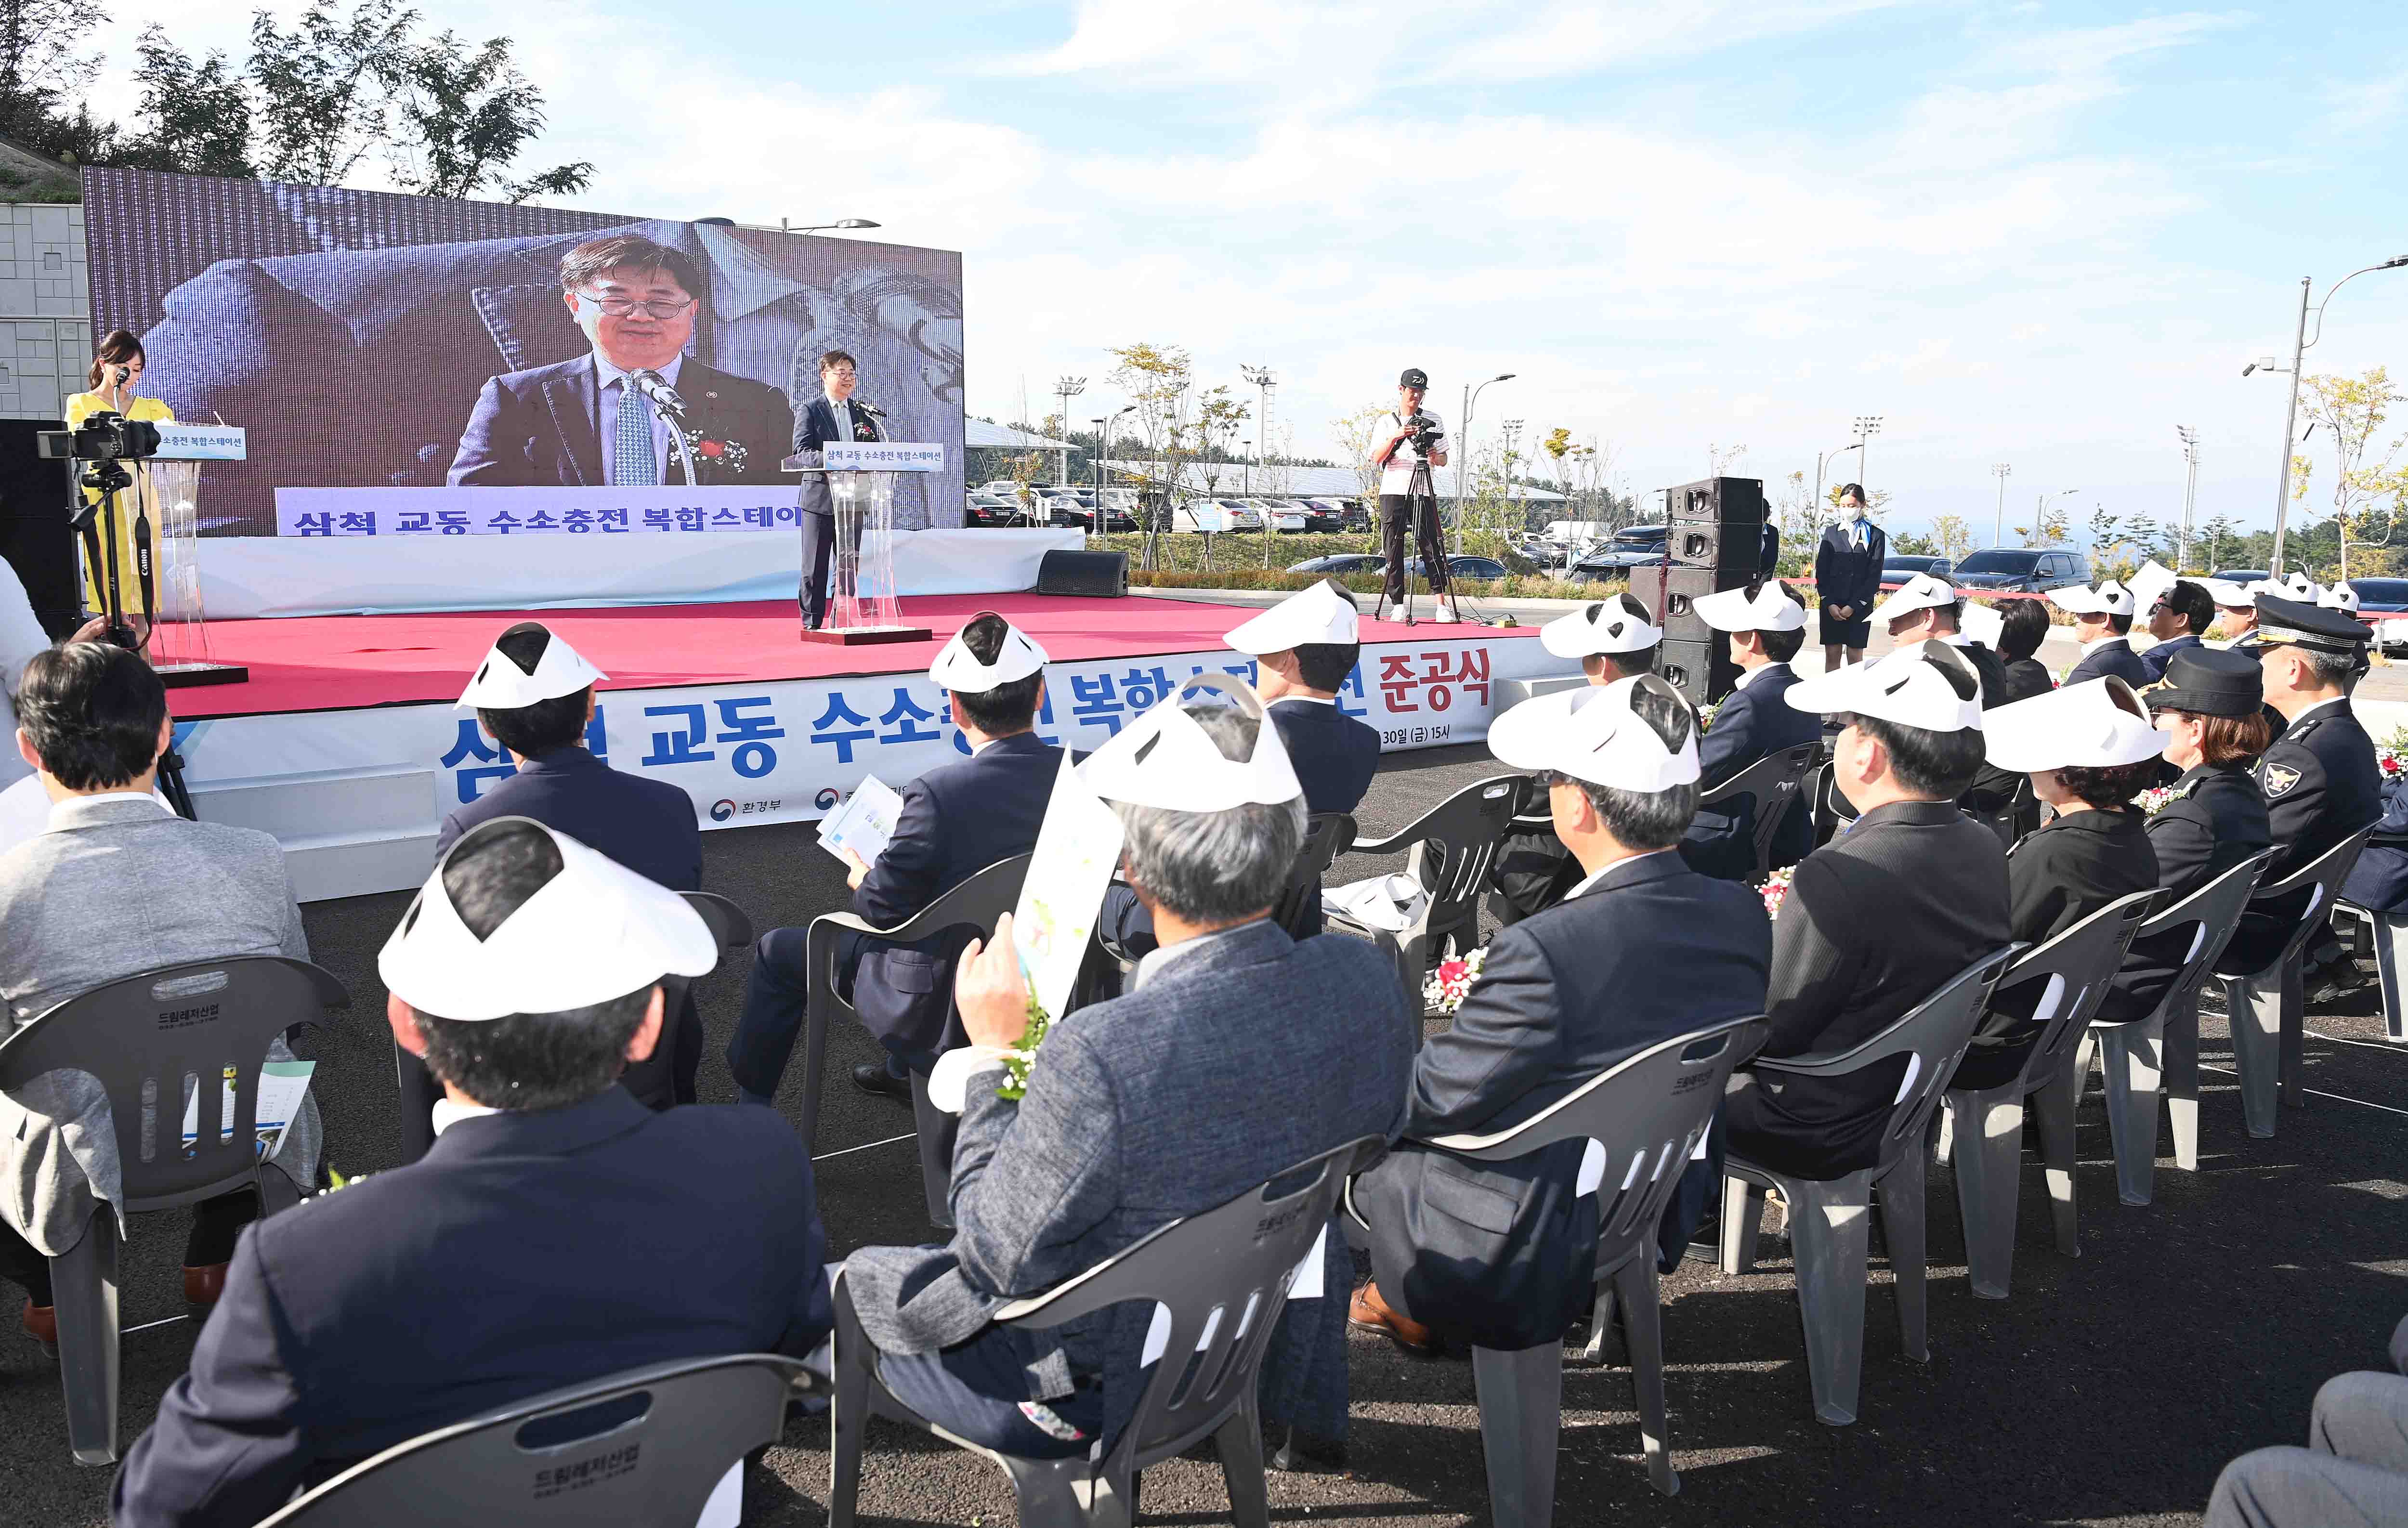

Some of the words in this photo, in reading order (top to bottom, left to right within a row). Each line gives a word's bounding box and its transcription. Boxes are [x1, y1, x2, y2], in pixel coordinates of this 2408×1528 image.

[161, 436, 188, 446] 소충전
[191, 436, 241, 447] 복합스테이션
[827, 450, 843, 460] 삼척
[846, 450, 861, 460] 교동
[864, 451, 894, 461] 수소충전
[897, 451, 941, 461] 복합스테이션
[294, 511, 377, 536] 삼척
[395, 510, 471, 535] 교동
[487, 507, 629, 535] 수소충전
[440, 705, 609, 804] 삼
[641, 696, 785, 778] 교동
[811, 674, 1059, 764] 수소
[1380, 648, 1490, 713] 준공식
[1383, 728, 1407, 744] 30일
[1411, 727, 1428, 743] (금)
[1431, 724, 1450, 740] 15시
[742, 799, 781, 814] 환경부
